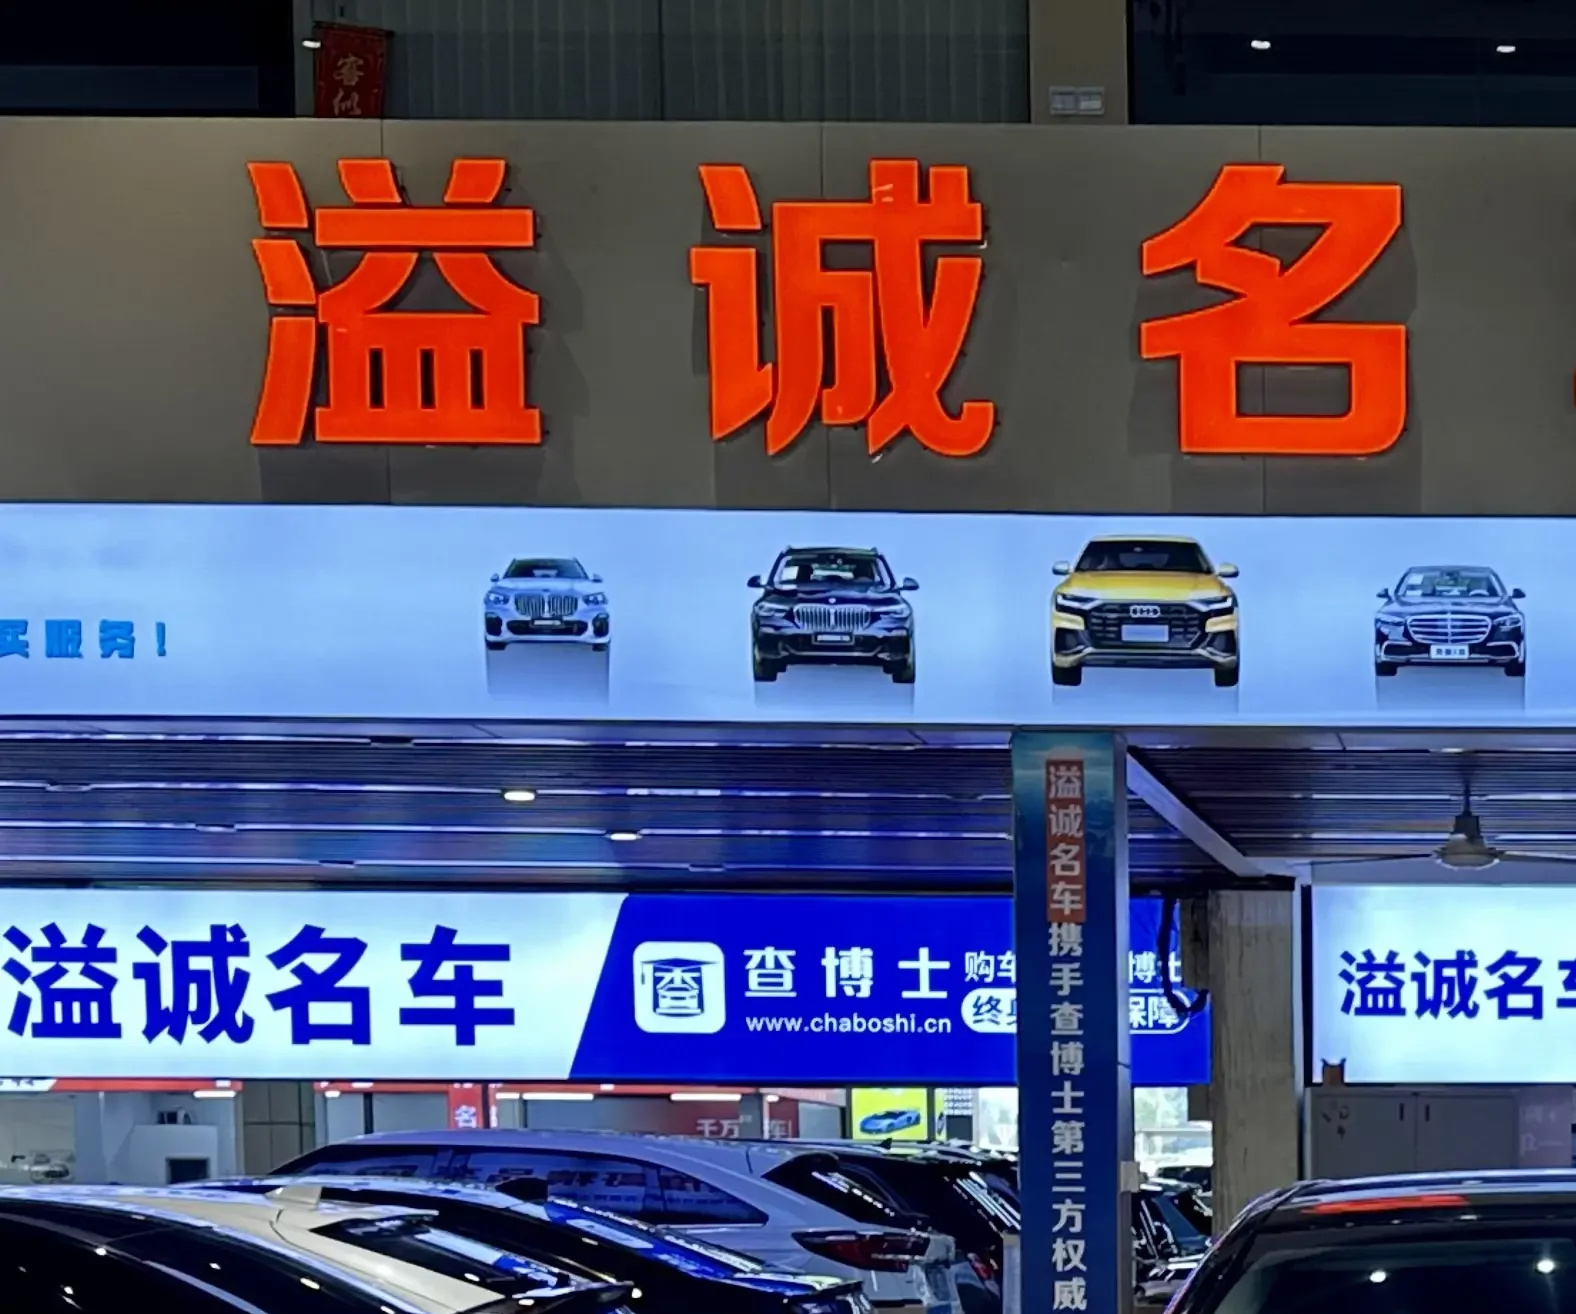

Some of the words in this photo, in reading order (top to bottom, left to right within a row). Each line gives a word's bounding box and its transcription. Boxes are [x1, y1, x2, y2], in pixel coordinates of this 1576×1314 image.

[2, 922, 516, 1047] 溢诚名车
[743, 945, 951, 1000] 查博士
[745, 1012, 952, 1034] www.chaboshi.cn
